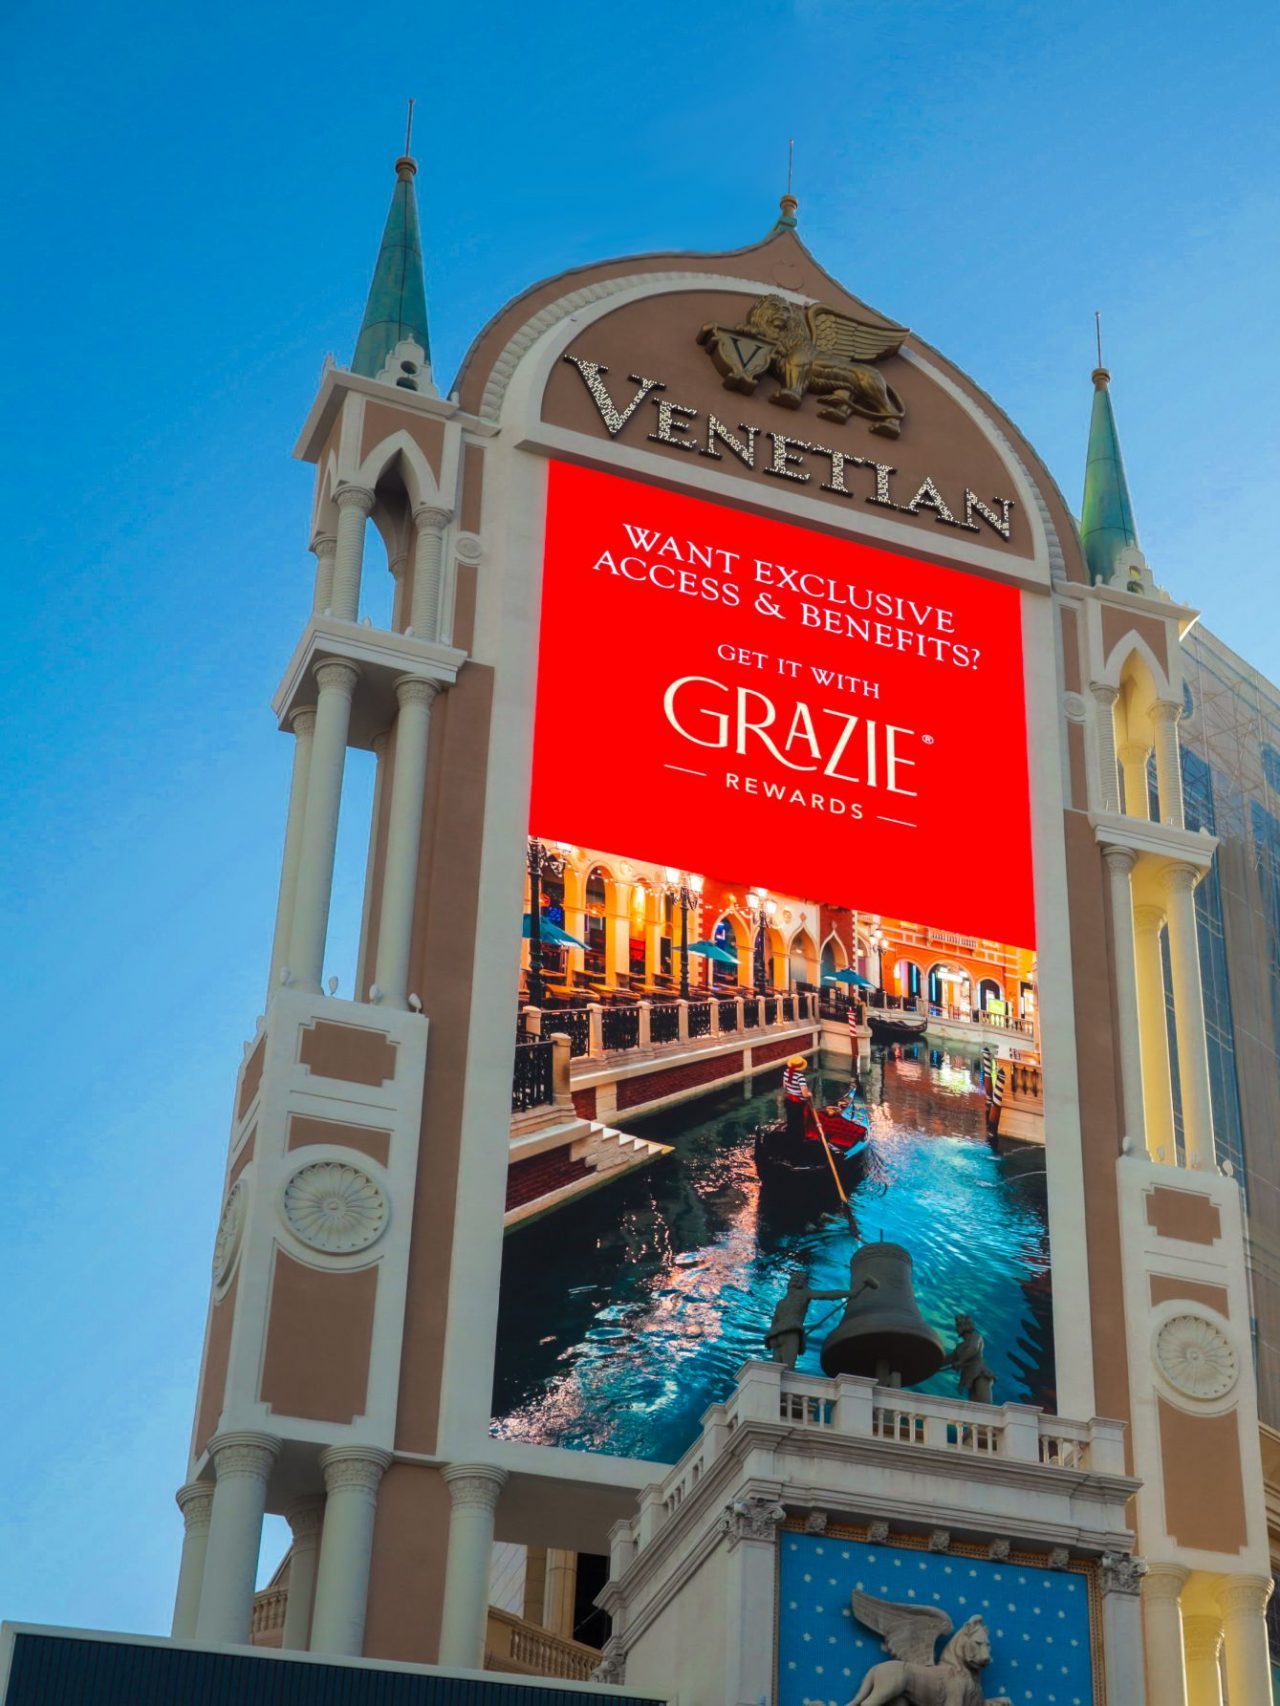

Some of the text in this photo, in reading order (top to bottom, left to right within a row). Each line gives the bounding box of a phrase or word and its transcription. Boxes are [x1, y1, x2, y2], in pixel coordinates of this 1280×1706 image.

[564, 354, 1014, 542] VENETIAN
[592, 549, 981, 671] ACCESS & BENEFITS?
[623, 523, 955, 634] WANT EXCLUSIVE
[717, 644, 880, 699] GET IT WITH
[725, 772, 864, 820] REWARDS
